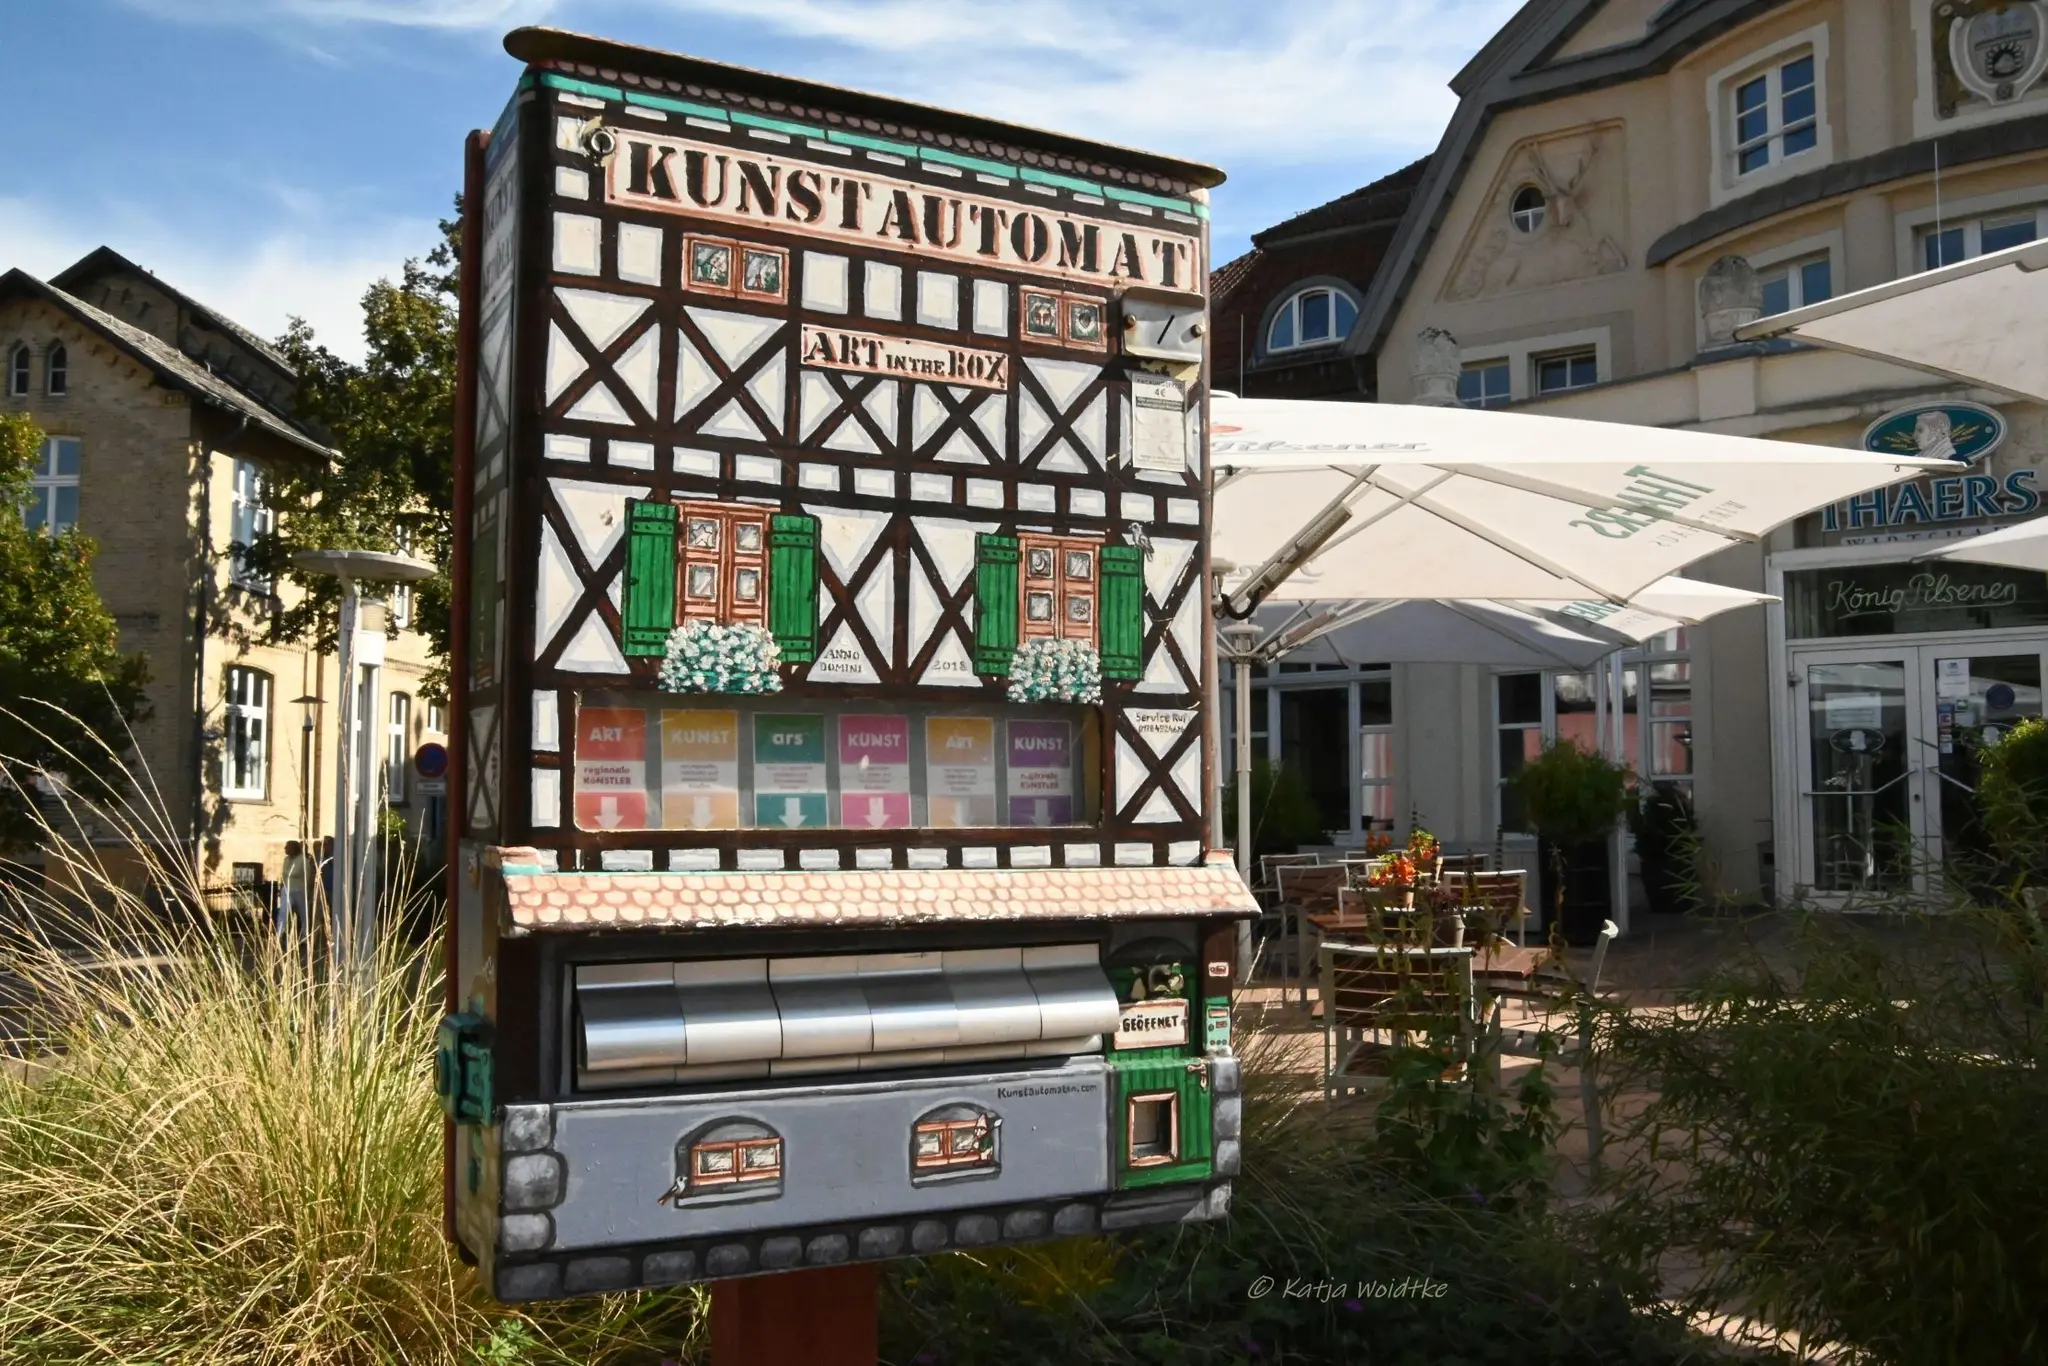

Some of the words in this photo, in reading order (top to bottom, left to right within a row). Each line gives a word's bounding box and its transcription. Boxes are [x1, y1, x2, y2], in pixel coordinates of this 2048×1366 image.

[626, 140, 1186, 287] KUNSTAUTOMAT
[805, 332, 884, 369] ART
[886, 354, 907, 371] IN
[908, 356, 945, 376] THE
[948, 350, 1006, 384] BOX
[1826, 580, 1904, 613] König
[824, 649, 860, 660] ANNO
[820, 661, 862, 673] DOMINI
[1136, 712, 1171, 723] Service
[589, 727, 623, 742] ART
[671, 730, 730, 744] KUNST
[848, 733, 901, 747] KUNST
[946, 736, 974, 749] ART
[1014, 736, 1063, 750] KUNST
[584, 766, 630, 776] regionale
[1122, 1014, 1179, 1032] GEÖFFNET
